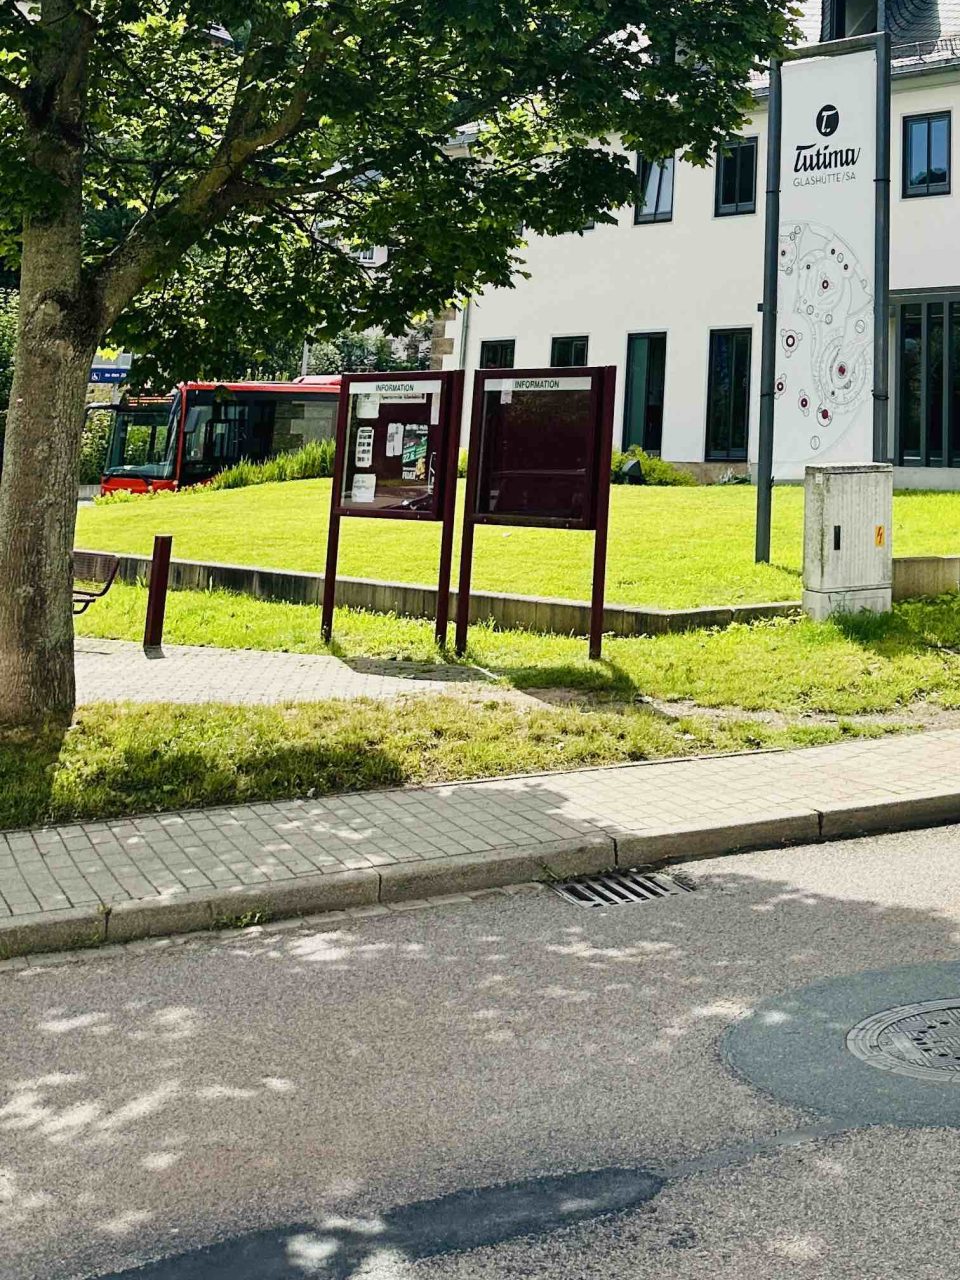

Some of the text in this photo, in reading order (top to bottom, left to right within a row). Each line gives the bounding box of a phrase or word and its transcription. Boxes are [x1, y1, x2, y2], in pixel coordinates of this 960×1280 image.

[793, 143, 861, 173] Tutima
[375, 383, 414, 392] INFORMATION
[514, 379, 560, 389] INFORMATION
